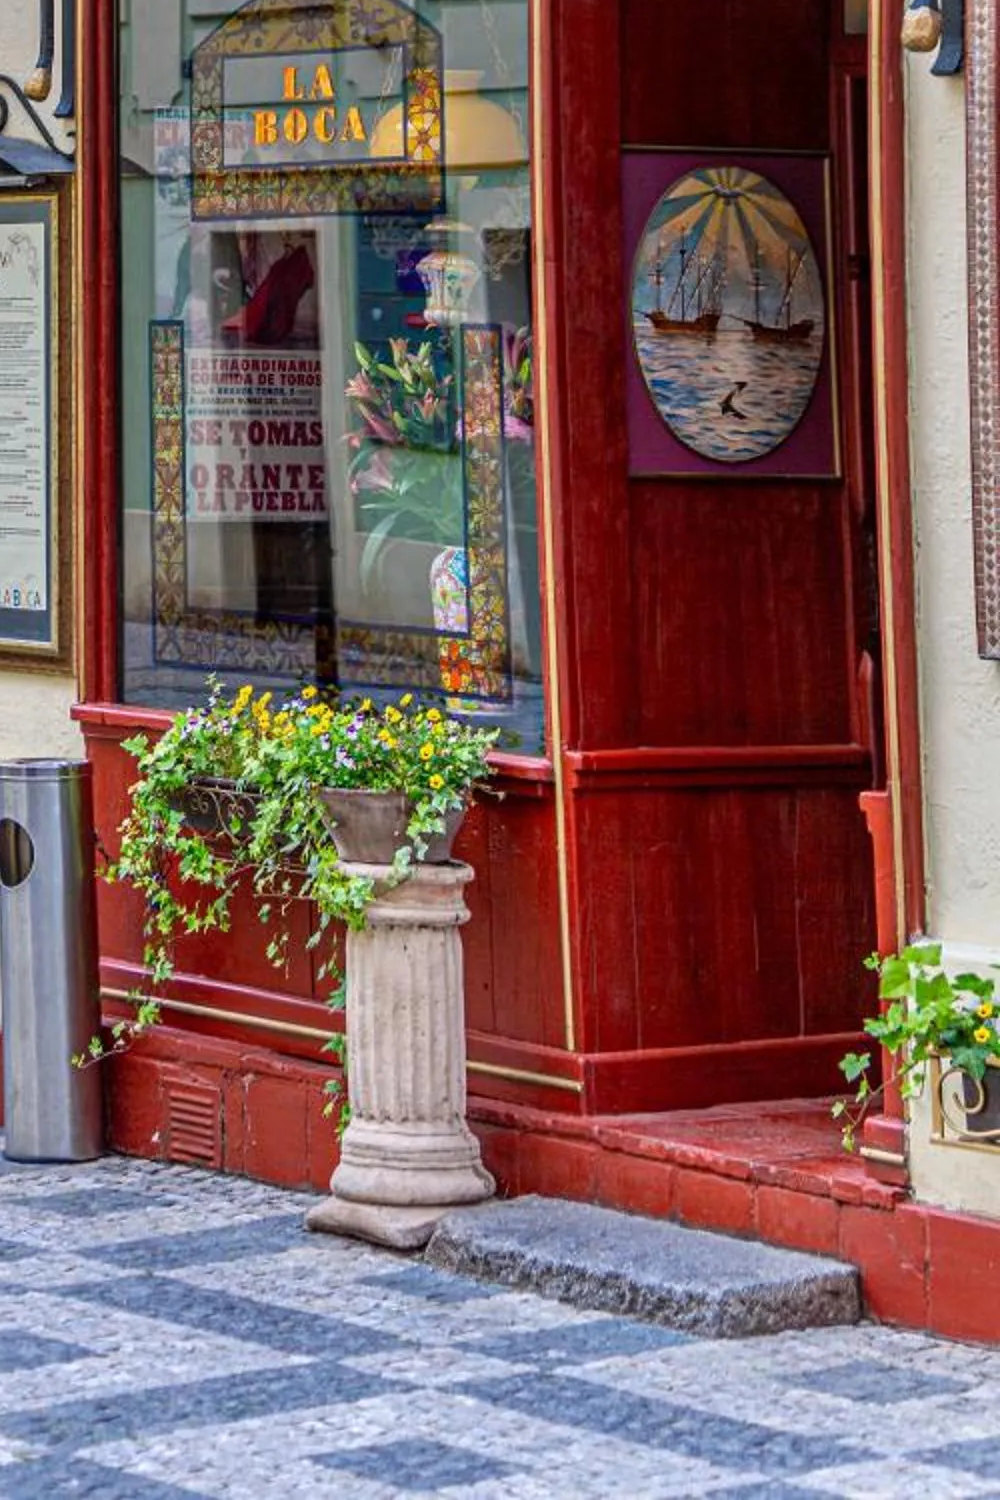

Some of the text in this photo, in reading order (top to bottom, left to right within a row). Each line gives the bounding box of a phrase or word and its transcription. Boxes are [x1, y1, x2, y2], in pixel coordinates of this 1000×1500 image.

[282, 63, 334, 100] LA
[253, 105, 366, 145] BOCA
[258, 373, 274, 385] DE
[280, 373, 322, 386] TOROS
[190, 419, 322, 447] SE TOMAS
[190, 463, 326, 490] ORANTE
[234, 491, 326, 512] PUEBLA
